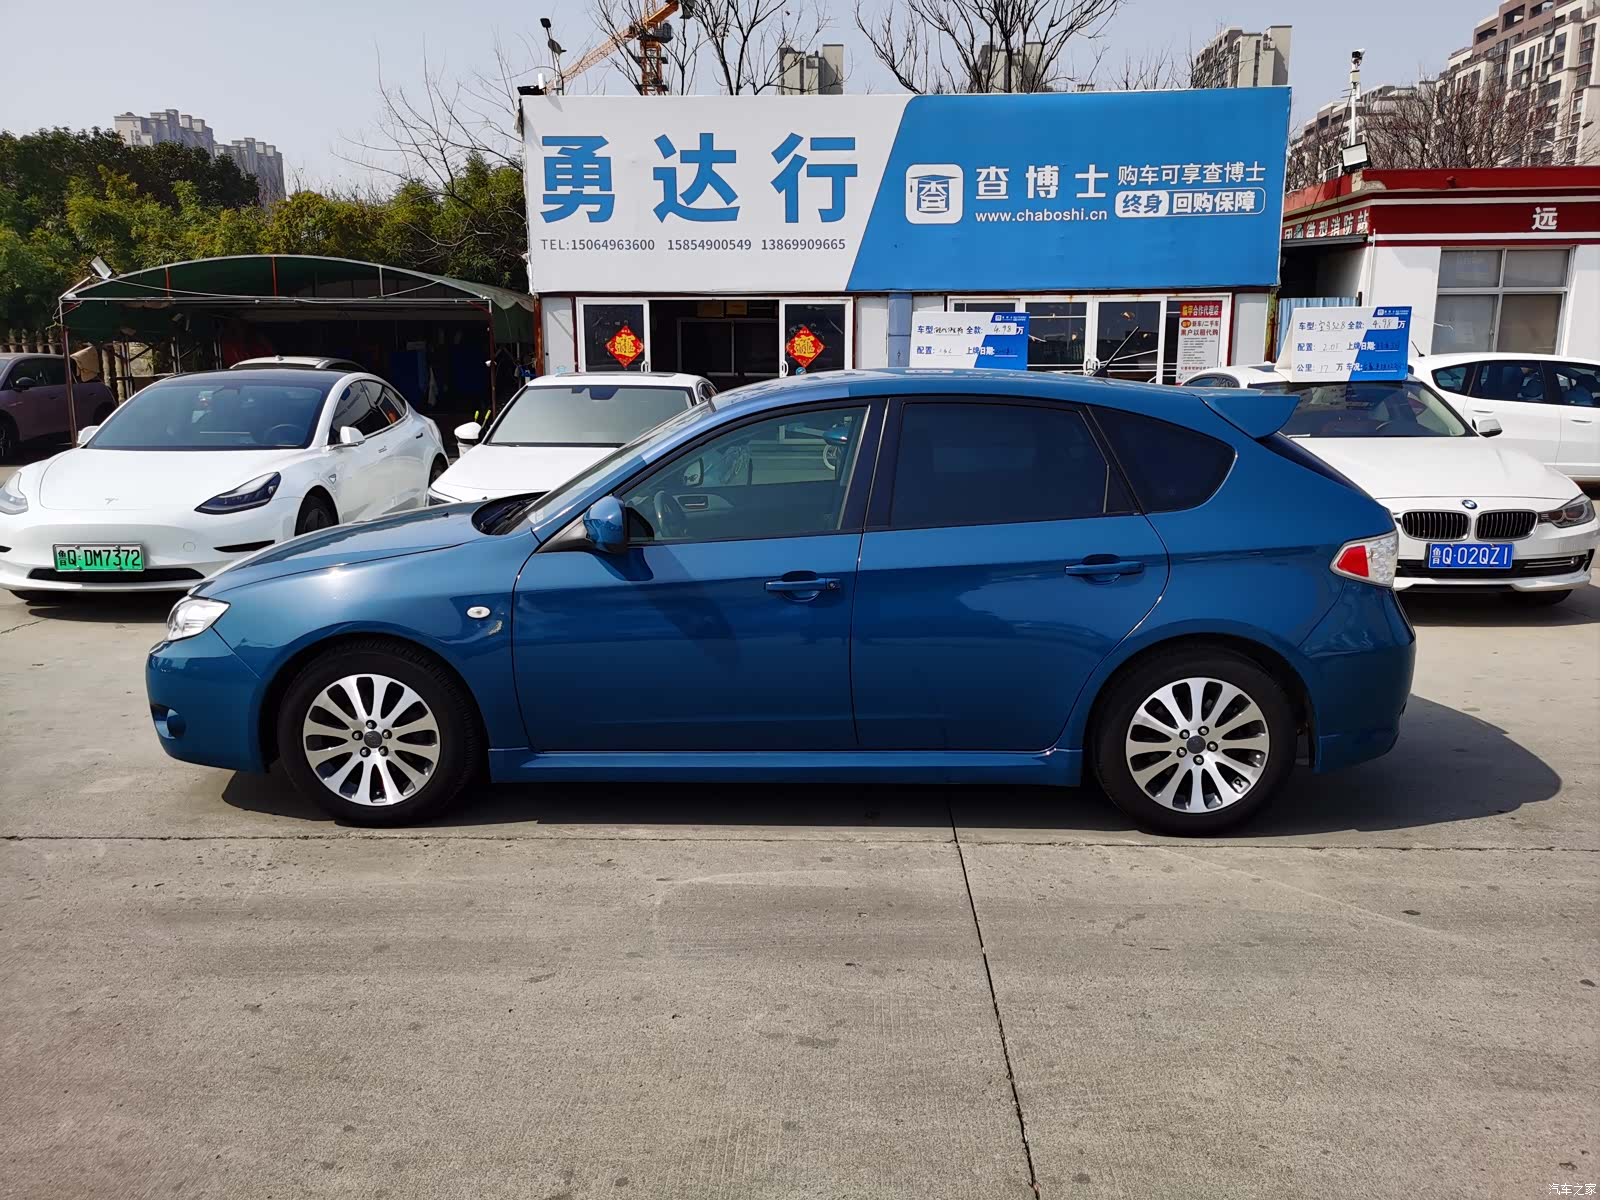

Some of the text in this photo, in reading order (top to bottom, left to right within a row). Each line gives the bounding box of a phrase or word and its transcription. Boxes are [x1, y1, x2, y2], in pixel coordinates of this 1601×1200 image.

[540, 132, 858, 223] 勇达行
[975, 164, 1109, 200] 查博士
[1117, 161, 1266, 185] 购车可享查博士
[1122, 191, 1257, 214] 终身 回购保障
[975, 207, 1108, 223] www.chaboshi.cn
[1531, 206, 1558, 231] 远
[540, 237, 846, 251] TEL:15064963600 15854900549 13869909665
[1016, 326, 1024, 335] 万
[1398, 320, 1406, 329] 万
[1336, 362, 1343, 371] 万
